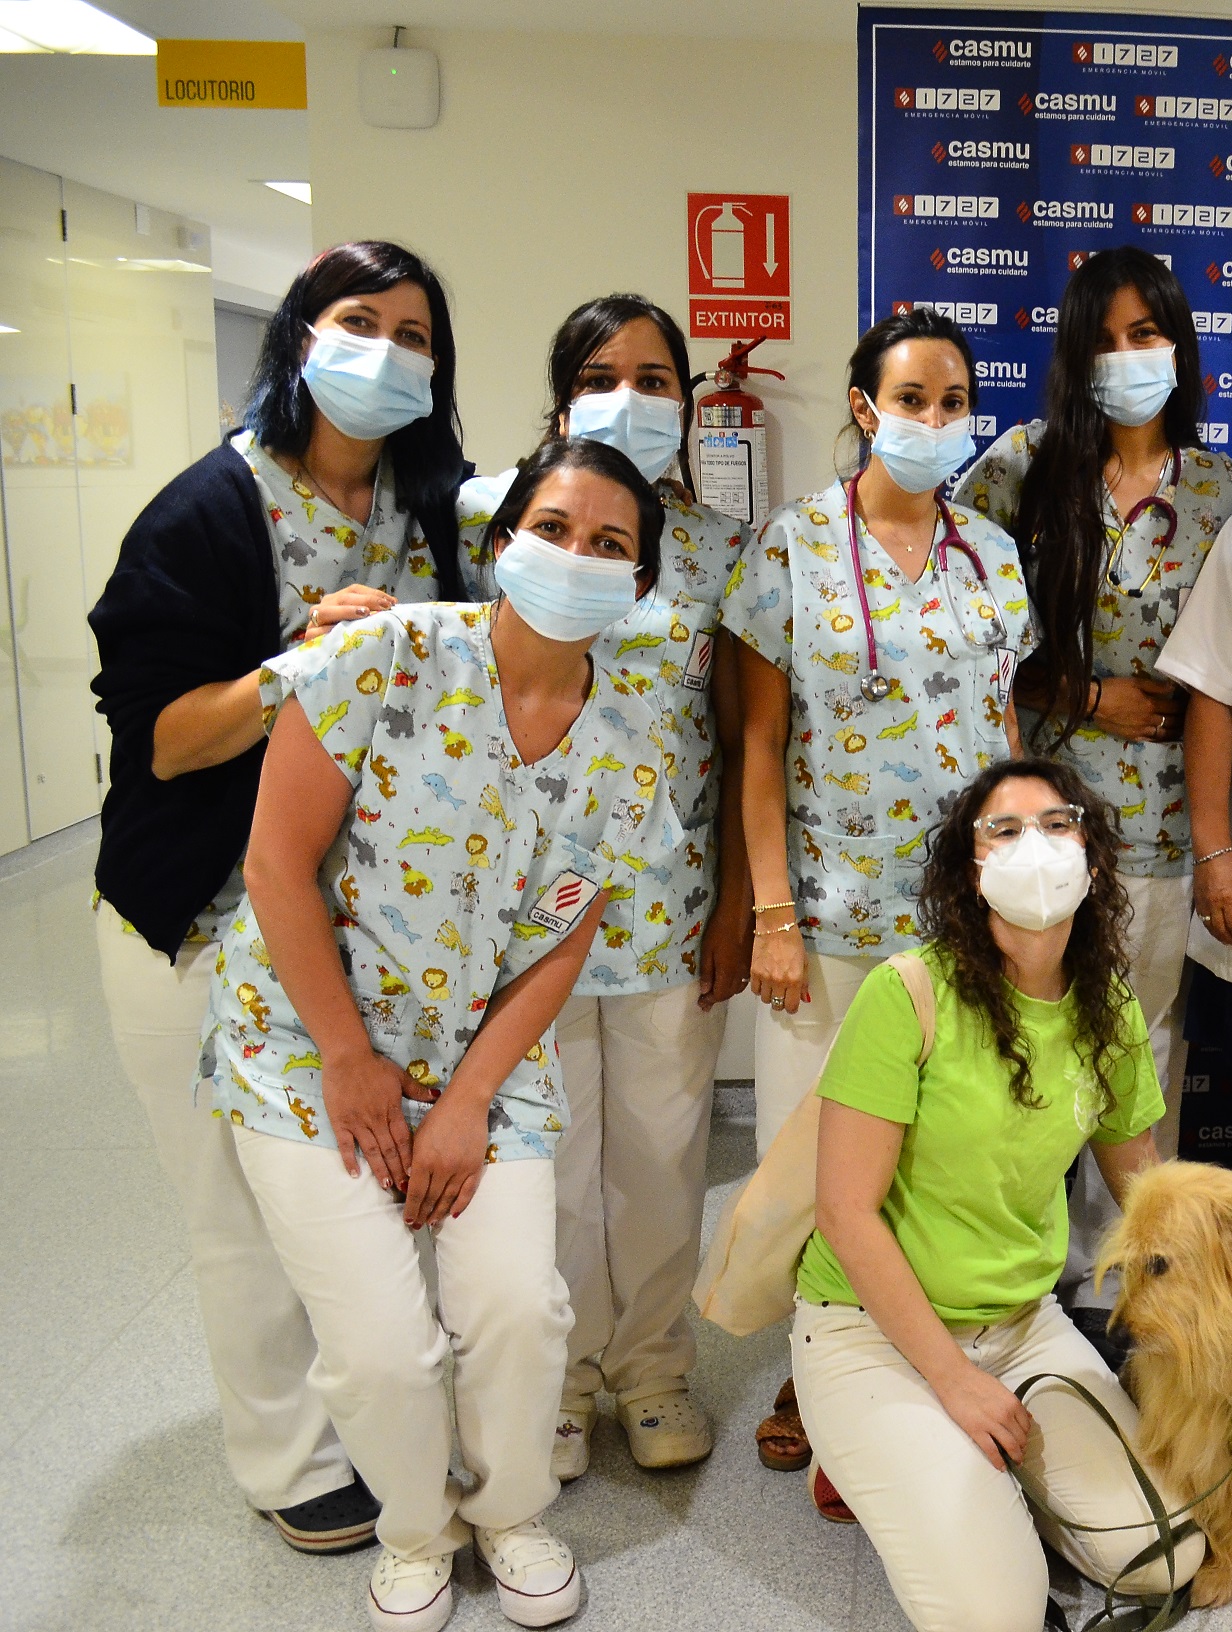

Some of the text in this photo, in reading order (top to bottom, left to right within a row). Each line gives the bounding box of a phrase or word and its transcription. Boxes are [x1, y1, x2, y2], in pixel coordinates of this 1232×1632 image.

[950, 39, 1032, 58] casmu
[950, 59, 981, 67] estamos
[1000, 60, 1031, 68] cuidarte
[165, 79, 255, 101] LOCUTORIO
[1035, 92, 1117, 111] casmu
[1035, 112, 1116, 121] estamos para cuidarte
[948, 140, 1030, 160] casmu
[999, 161, 1030, 169] cuidarte
[1033, 200, 1114, 219] casmu
[1033, 219, 1113, 229] estamos para cuidarte
[947, 247, 1028, 267] casmu
[947, 266, 1028, 276] estamos para cuidarte
[696, 310, 785, 329] EXTINTOR
[1031, 325, 1058, 333] estamo
[975, 361, 1027, 379] smu
[533, 911, 563, 930] casmu
